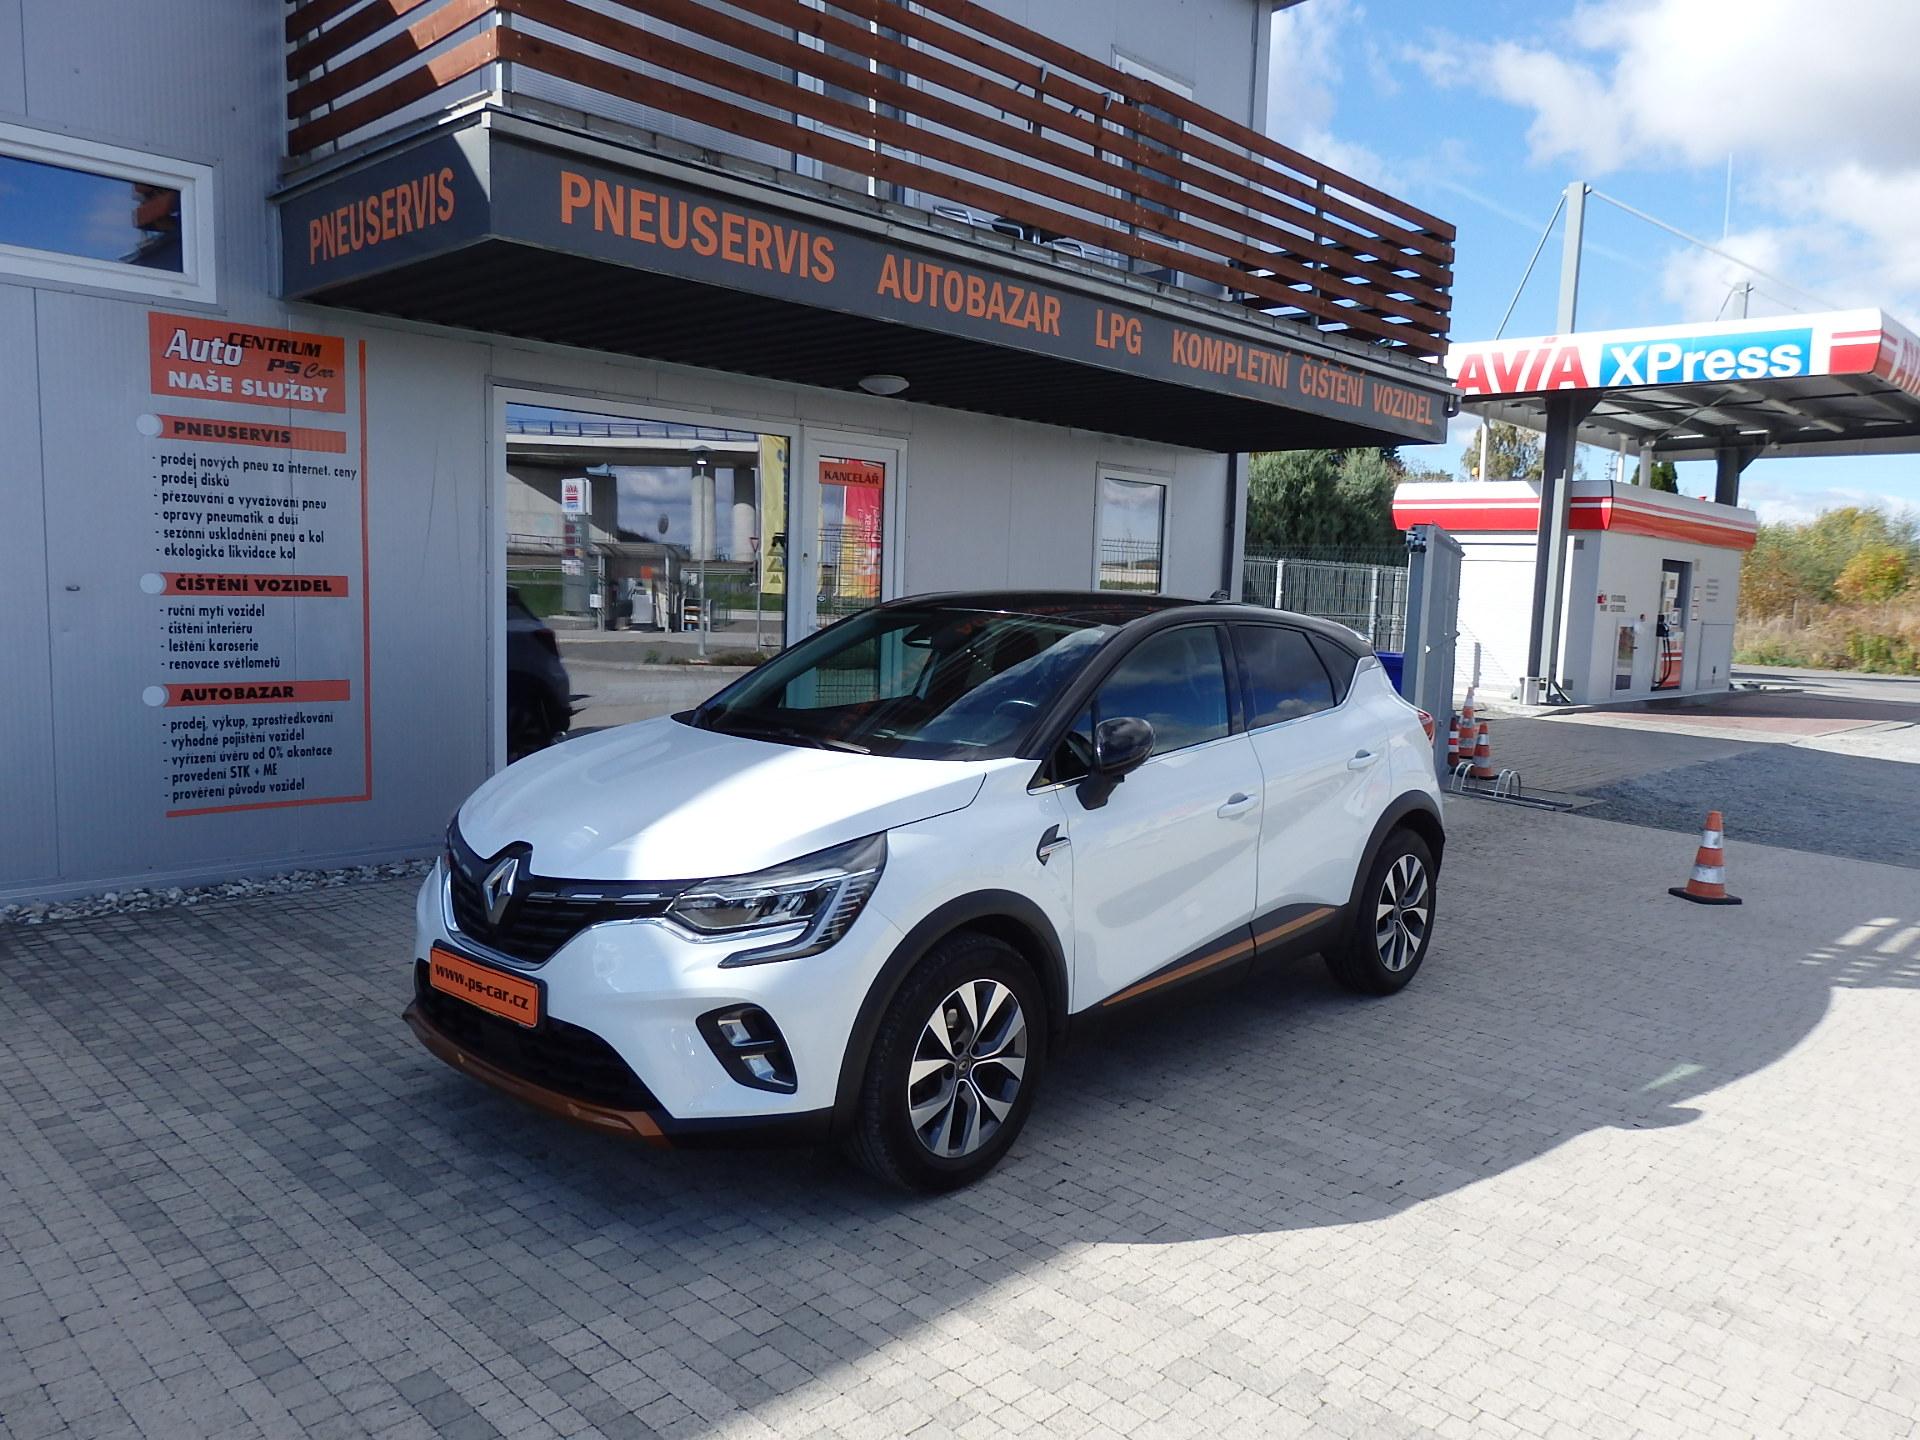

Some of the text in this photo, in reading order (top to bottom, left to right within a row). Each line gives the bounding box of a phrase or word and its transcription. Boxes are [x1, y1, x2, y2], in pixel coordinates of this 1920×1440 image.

[308, 166, 455, 265] PNEUSERVIS
[559, 170, 1433, 426] PNEUSERVIS AUTOBAZAR LPG KOMPLETNÍ ČIŠTĚNÍ VOZIDEL
[164, 328, 243, 366] Auto
[227, 332, 323, 358] CENTRUM
[266, 358, 336, 380] PS Car
[1607, 342, 1803, 386] XPress
[168, 369, 329, 404] NAŠE SLUŽBY
[173, 421, 292, 443] PNEUSERVIS
[160, 452, 197, 470] prodej
[200, 456, 239, 472] nových
[243, 461, 268, 473] pneu
[272, 463, 284, 473] za
[334, 467, 357, 480] ceny
[161, 471, 197, 489] prodej
[825, 470, 879, 485] KANCELÁŘ
[162, 490, 224, 505] přezouvání
[228, 496, 234, 505] a
[302, 500, 327, 512] pneu
[163, 511, 202, 524] opravy
[207, 511, 264, 525] pneumatik
[268, 515, 274, 524] a
[209, 526, 267, 541] uskladnění
[270, 532, 295, 544] pneu
[299, 534, 305, 543] a
[309, 530, 324, 543] kol
[164, 543, 296, 561] ekologická likvidace kol
[176, 574, 332, 592] ČIŠTĚNÍ VOZIDEL
[168, 604, 195, 616] ruční
[228, 603, 265, 617] vozidel
[168, 621, 253, 634] čištění interiéru
[169, 638, 259, 652] leštění karoserie
[169, 655, 280, 670] renovace světlometů
[181, 686, 295, 702] AUTOBAZAR
[171, 728, 305, 751] výhodné pojištění vozidel
[253, 747, 265, 759] od
[268, 746, 283, 759] 0%
[287, 744, 333, 758] akontace
[172, 767, 227, 786] provedení
[230, 765, 251, 778] STK
[263, 763, 277, 776] ME
[228, 781, 266, 799] původu
[269, 777, 305, 792] vozidel
[435, 963, 529, 1010] www.ps-car.cz
